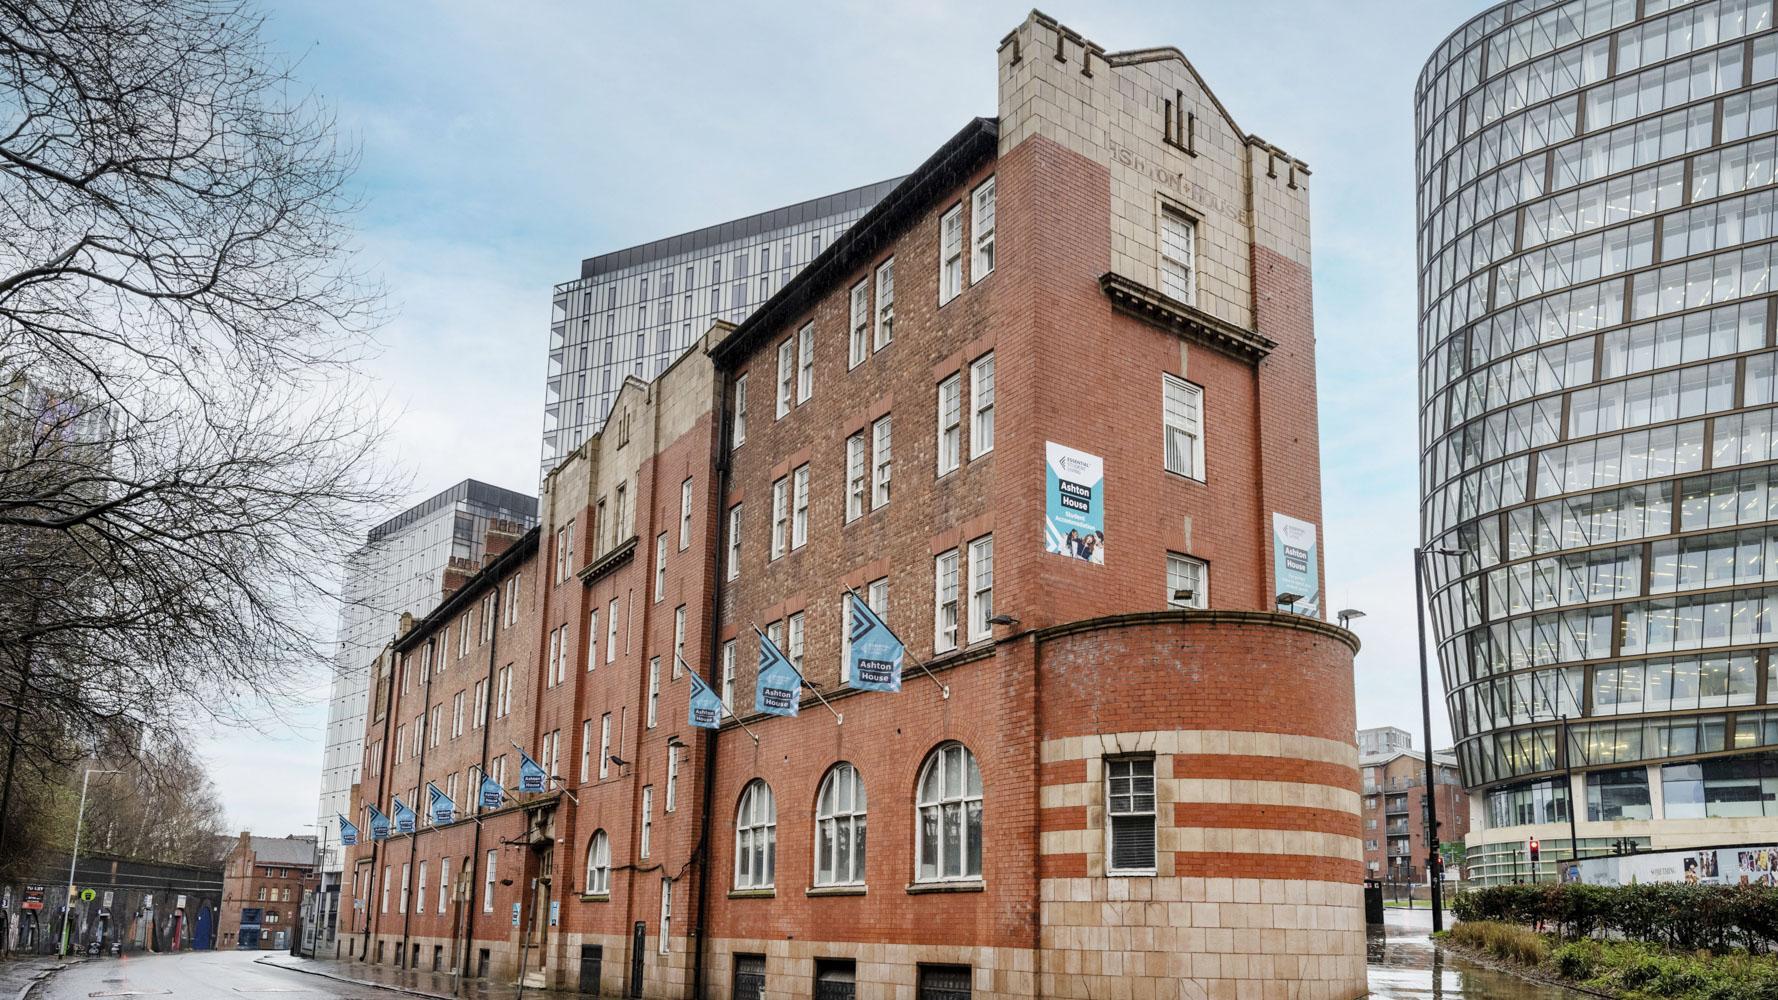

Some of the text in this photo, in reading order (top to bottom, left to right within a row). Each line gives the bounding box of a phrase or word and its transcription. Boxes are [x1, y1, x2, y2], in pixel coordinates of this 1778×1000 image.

[1061, 481, 1090, 497] Ashton
[1063, 497, 1088, 510] House
[1285, 547, 1306, 558] Ashton
[1287, 560, 1305, 571] House
[860, 661, 892, 670] Ashton
[862, 672, 889, 682] House
[765, 689, 791, 698] Ashton
[765, 699, 789, 707] House
